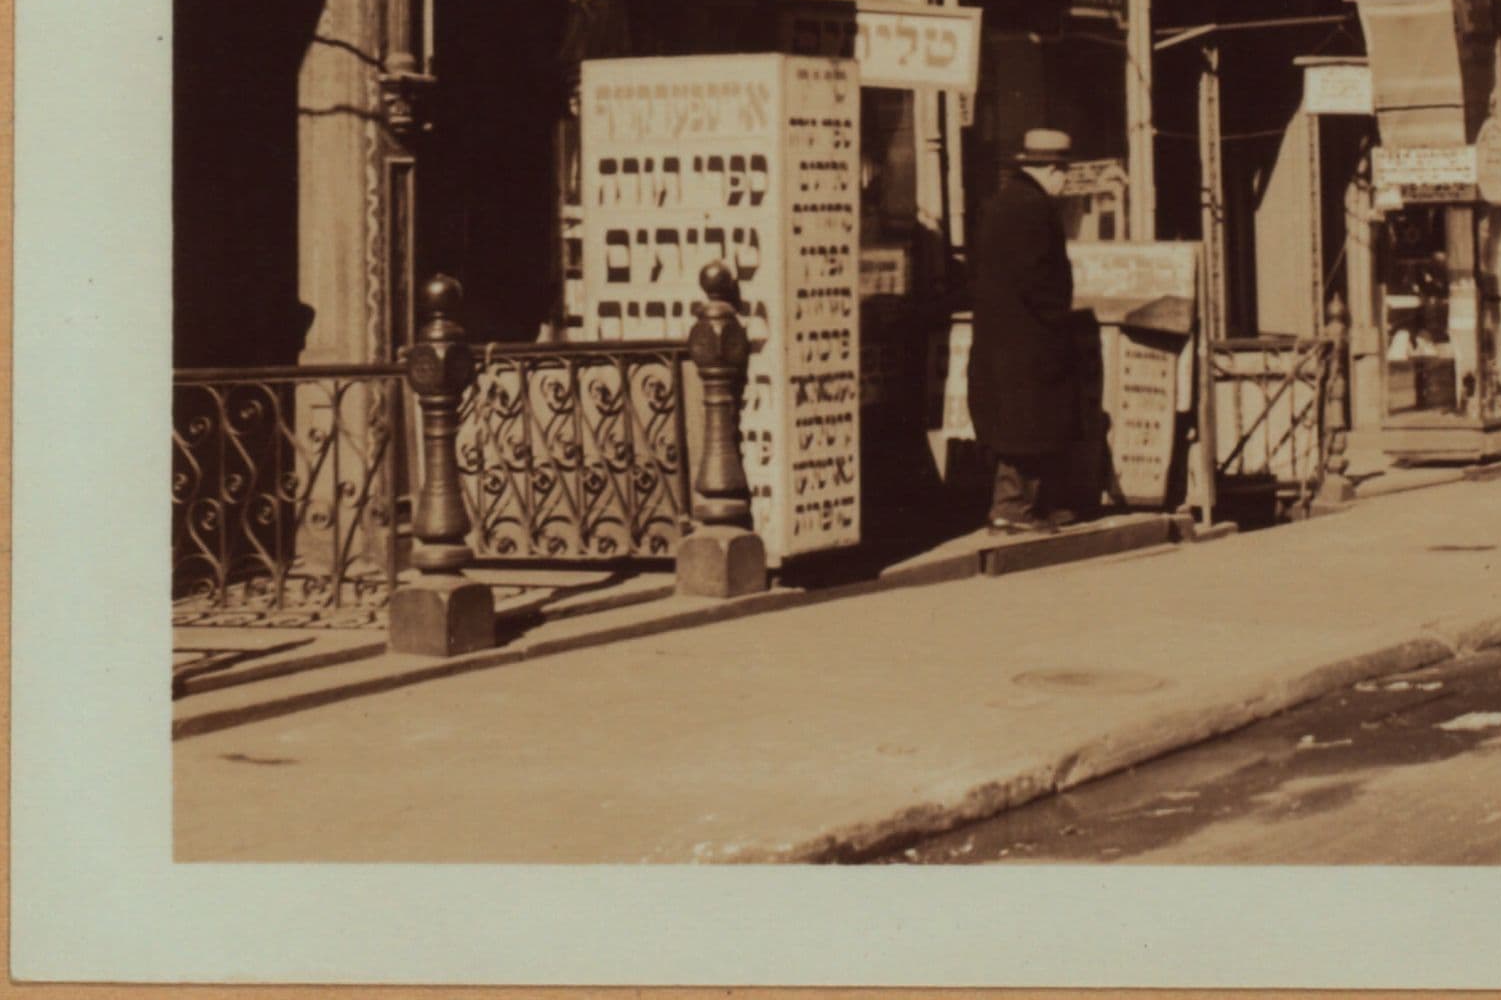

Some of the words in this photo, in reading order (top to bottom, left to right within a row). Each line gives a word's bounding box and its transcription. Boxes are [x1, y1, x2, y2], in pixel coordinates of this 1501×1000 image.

[597, 154, 682, 208] תורה
[692, 153, 769, 208] ספרי
[604, 226, 761, 284] טליתים
